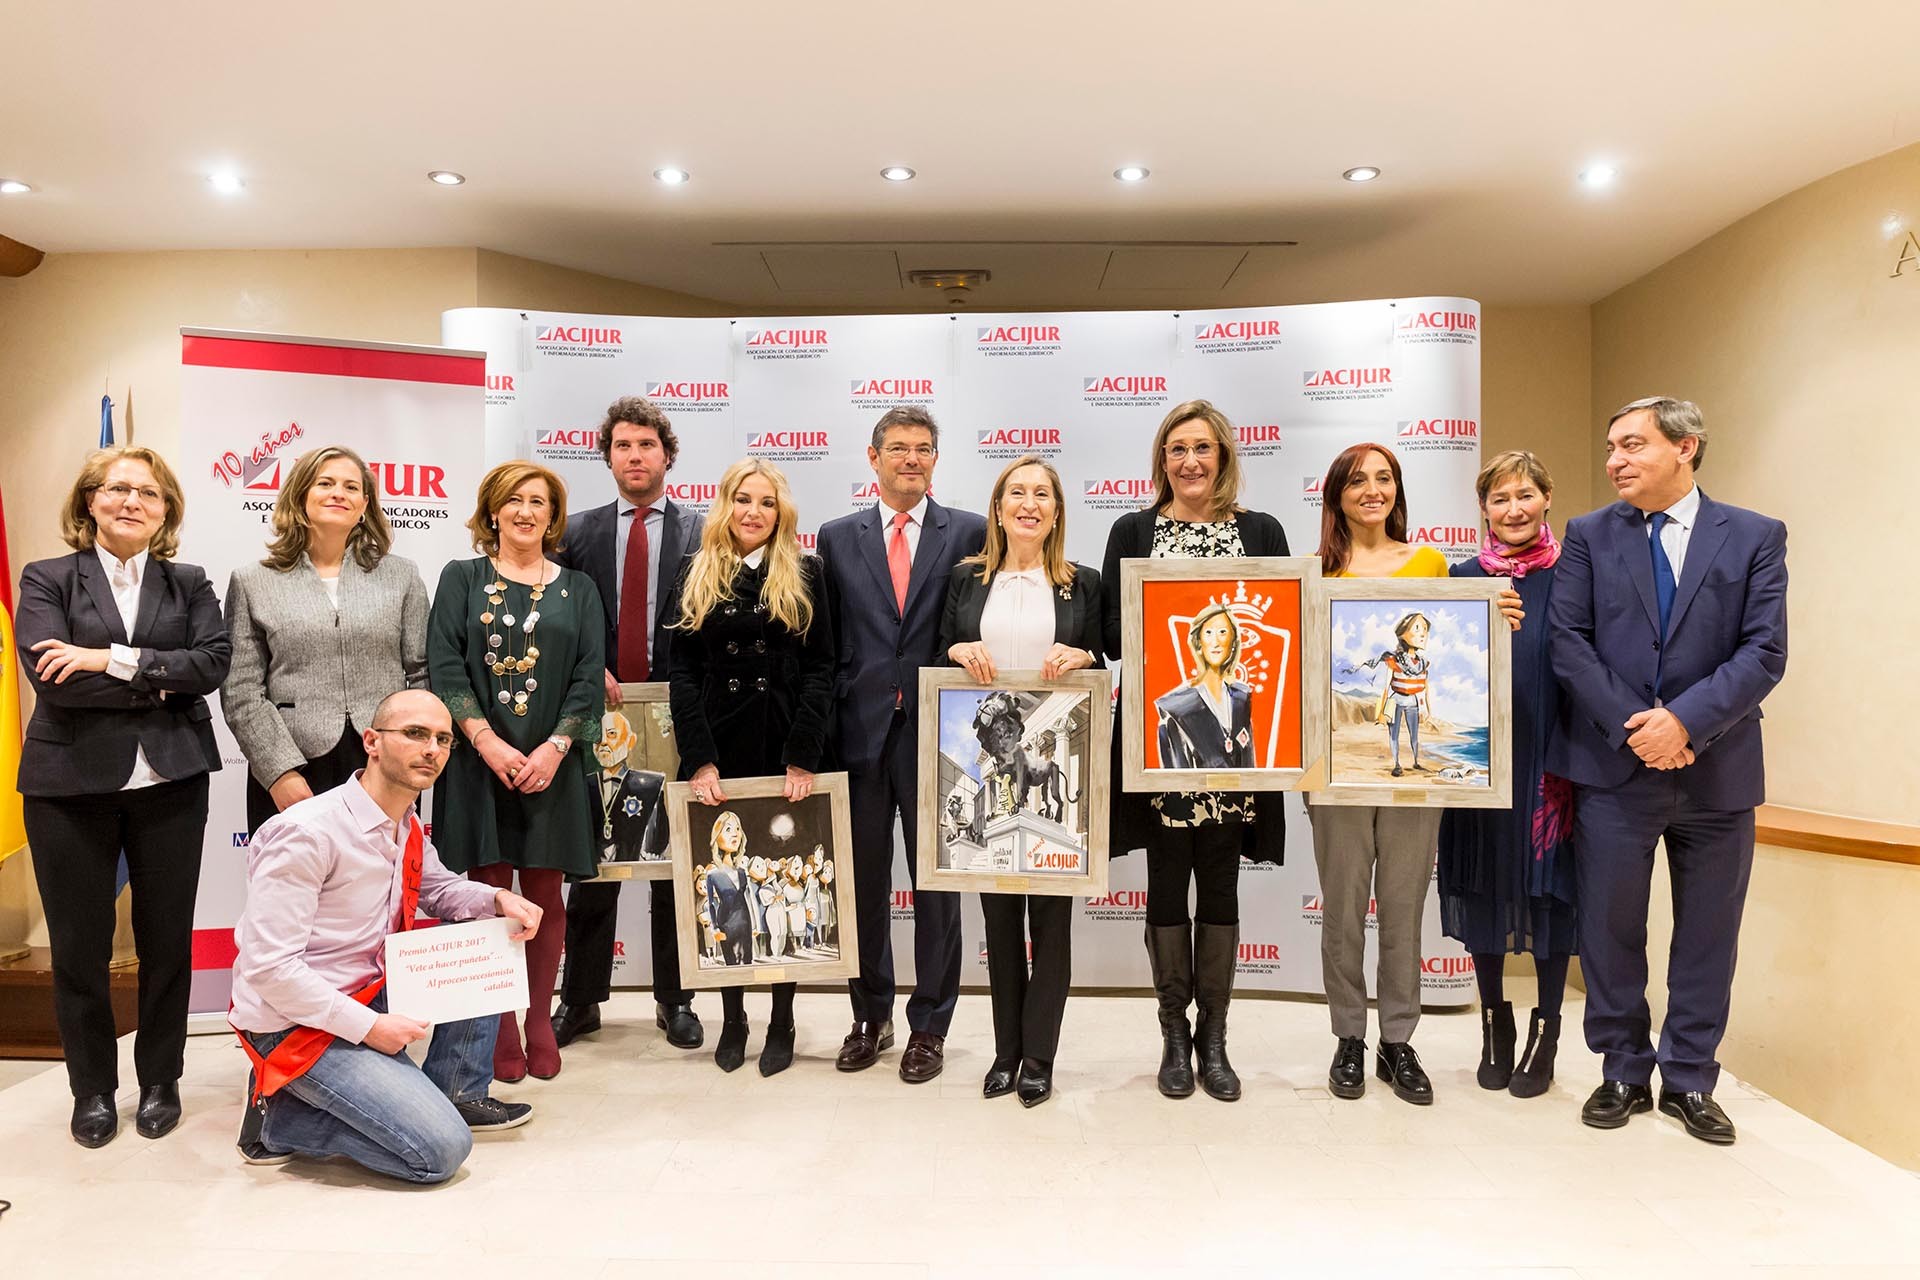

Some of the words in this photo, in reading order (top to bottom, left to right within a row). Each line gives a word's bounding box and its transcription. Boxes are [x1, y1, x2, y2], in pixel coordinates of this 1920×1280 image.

[1212, 321, 1280, 341] ACIJUR
[1415, 312, 1476, 332] ACIJUR
[553, 327, 622, 346] ACIJUR
[762, 330, 828, 348] ACIJUR
[994, 327, 1060, 345] ACIJUR
[1101, 377, 1168, 396] ACIJUR
[1321, 368, 1392, 388] ACIJUR
[663, 383, 729, 402] ACIJUR
[868, 380, 933, 398] ACIJUR
[995, 429, 1060, 448] ACIJUR
[1415, 420, 1477, 439] ACIJUR
[763, 432, 828, 451] ACIJUR
[213, 451, 242, 486] 10
[251, 422, 302, 464] años
[666, 484, 720, 503] ACIJU
[1101, 480, 1153, 499] ACIJU
[262, 514, 268, 523] E
[391, 517, 430, 530] ÍDICOS
[382, 507, 448, 519] NICADORES
[1415, 527, 1477, 547] ACIJUR
[1044, 853, 1079, 870] ACIJUR
[399, 947, 427, 957] Premio
[429, 941, 462, 953] ACIJUR
[465, 937, 486, 947] 2017
[1238, 944, 1280, 963] IJUR
[436, 961, 457, 969] hacer
[427, 979, 436, 988] Al
[438, 976, 468, 989] proceso
[469, 968, 514, 981] secesionista
